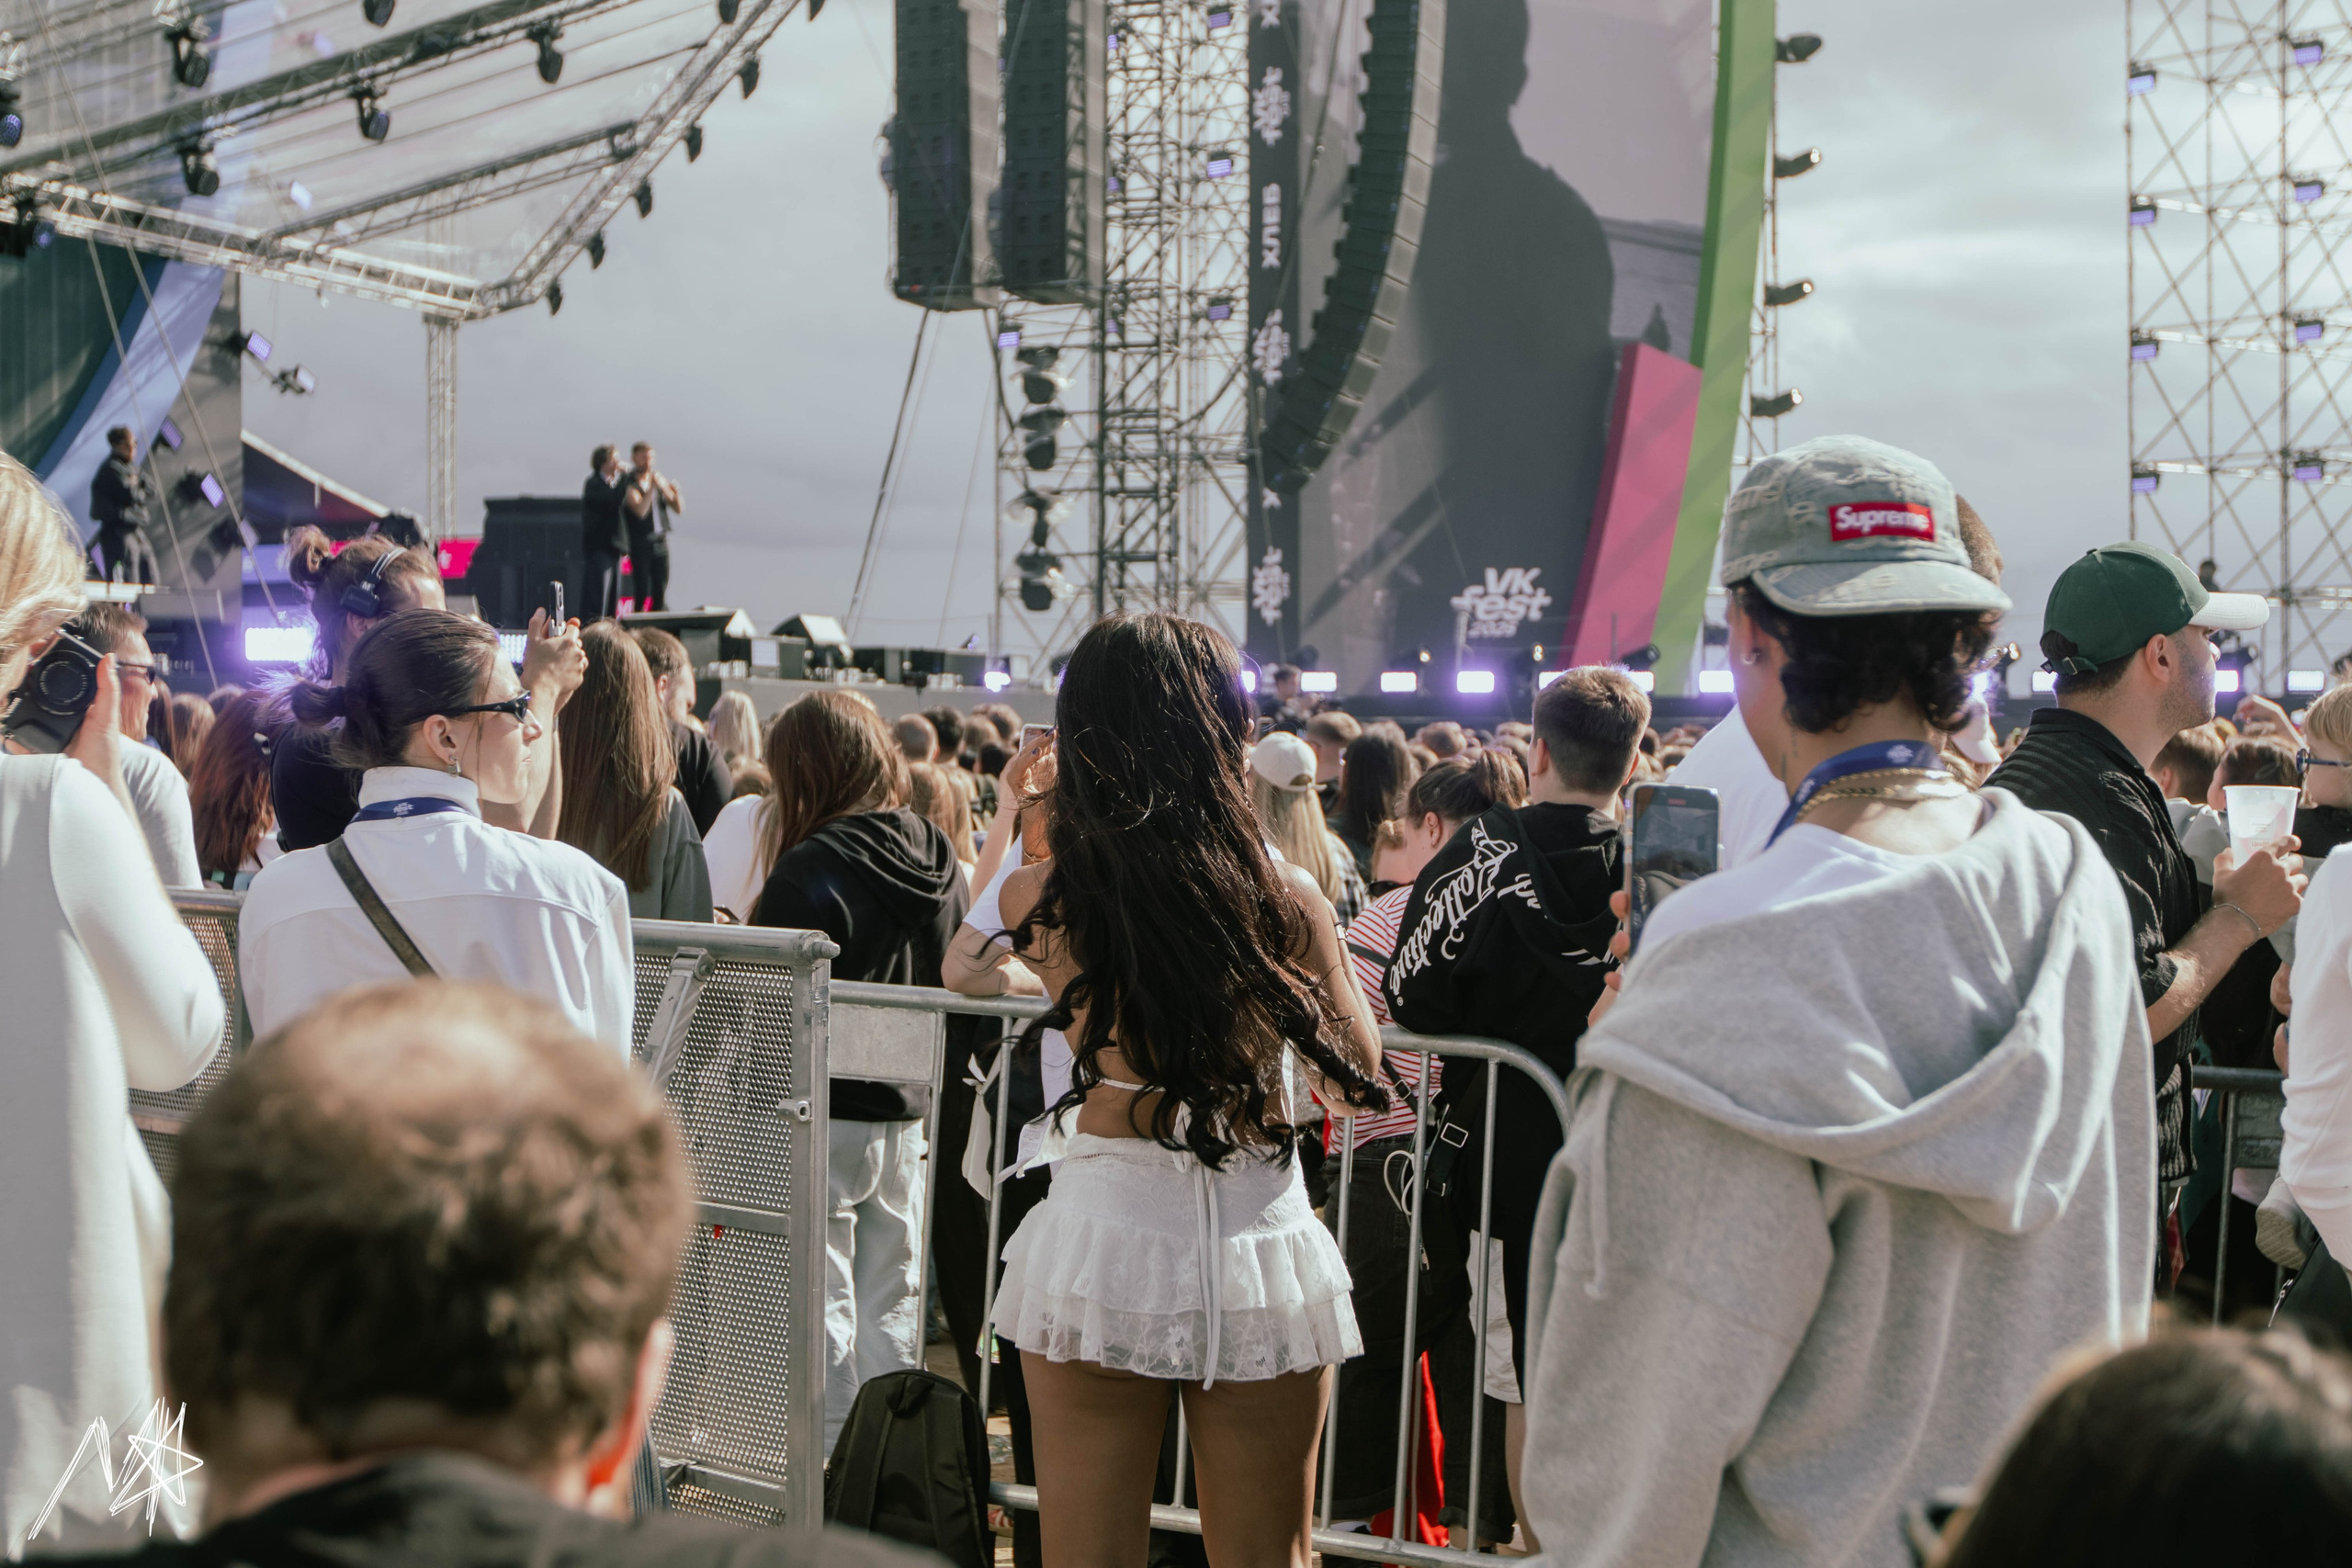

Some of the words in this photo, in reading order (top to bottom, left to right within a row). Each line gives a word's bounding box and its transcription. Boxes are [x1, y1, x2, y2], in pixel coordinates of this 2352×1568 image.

[1261, 66, 1283, 147] fest
[1261, 183, 1282, 269] ХЛЕБ
[1835, 505, 1929, 535] Supreme
[1484, 567, 1542, 594] VK
[1450, 584, 1553, 622] fest
[1467, 621, 1519, 638] 2025
